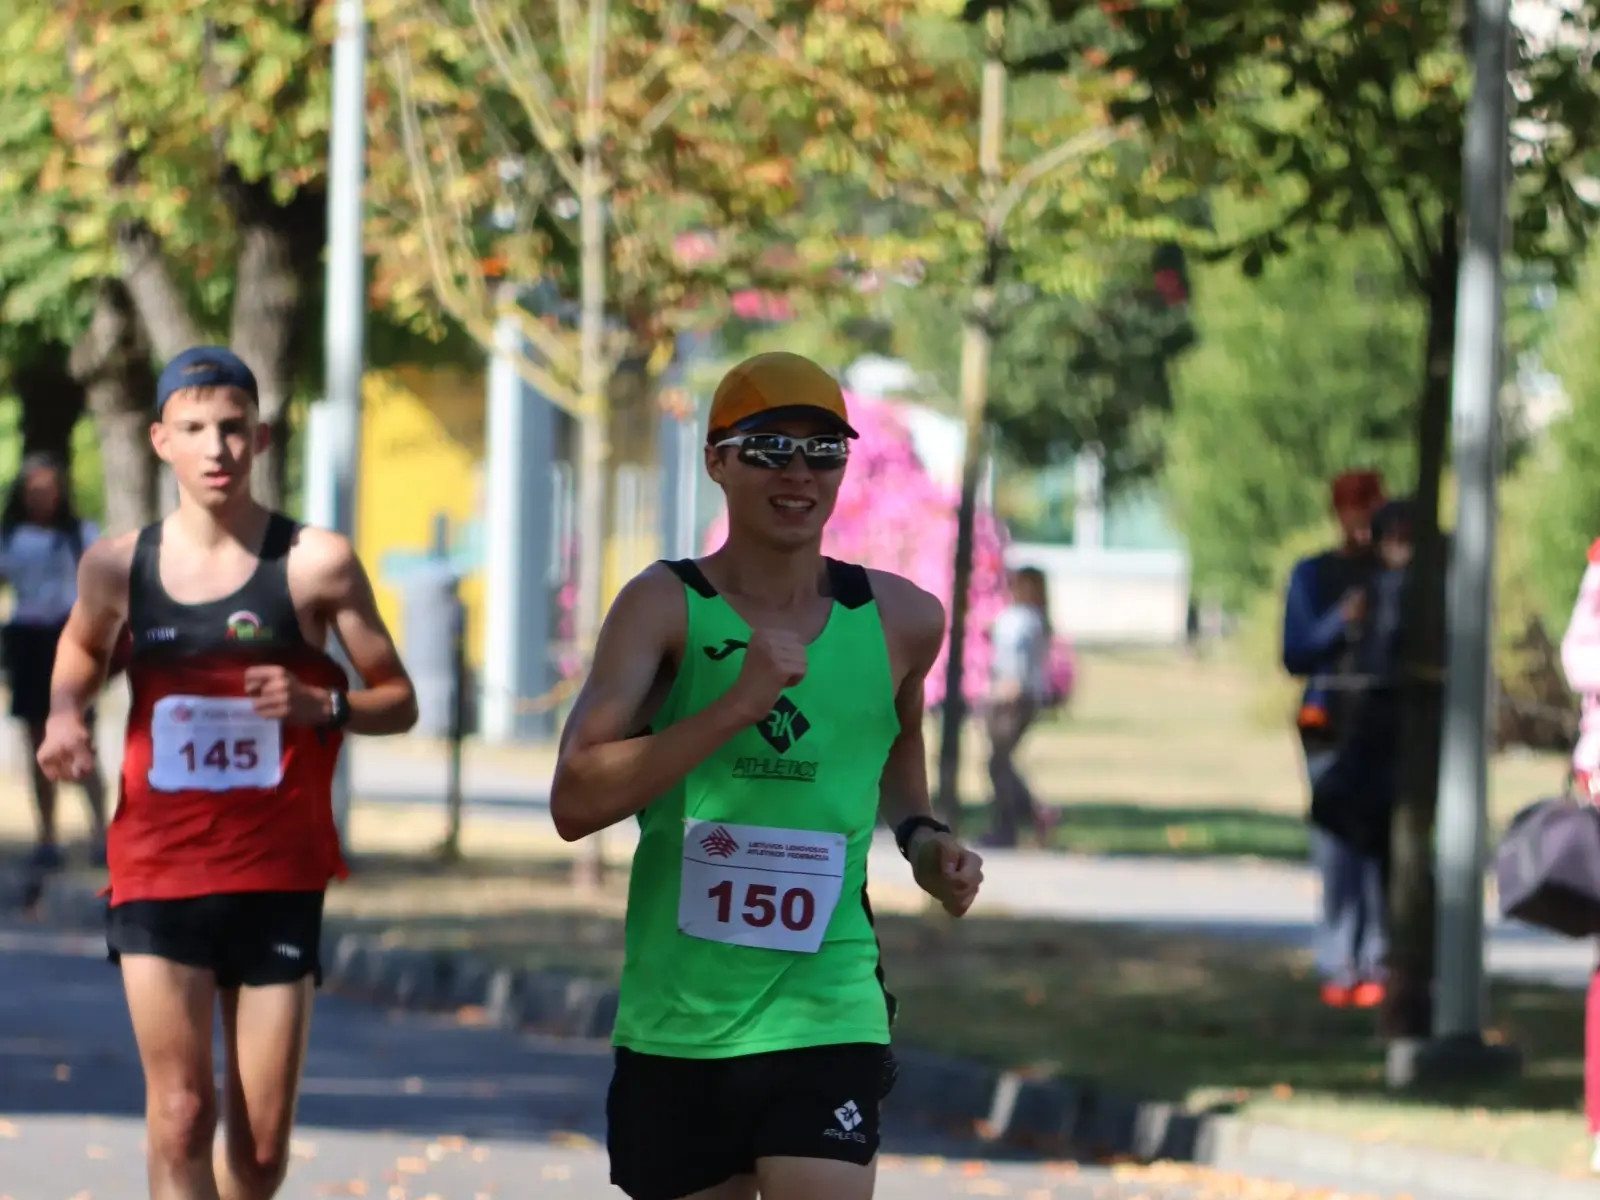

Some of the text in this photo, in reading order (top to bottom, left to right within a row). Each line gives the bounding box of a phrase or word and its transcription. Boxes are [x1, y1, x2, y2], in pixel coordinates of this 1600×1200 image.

[179, 739, 258, 773] 145
[732, 757, 818, 777] ATHLETICS
[708, 880, 815, 931] 150
